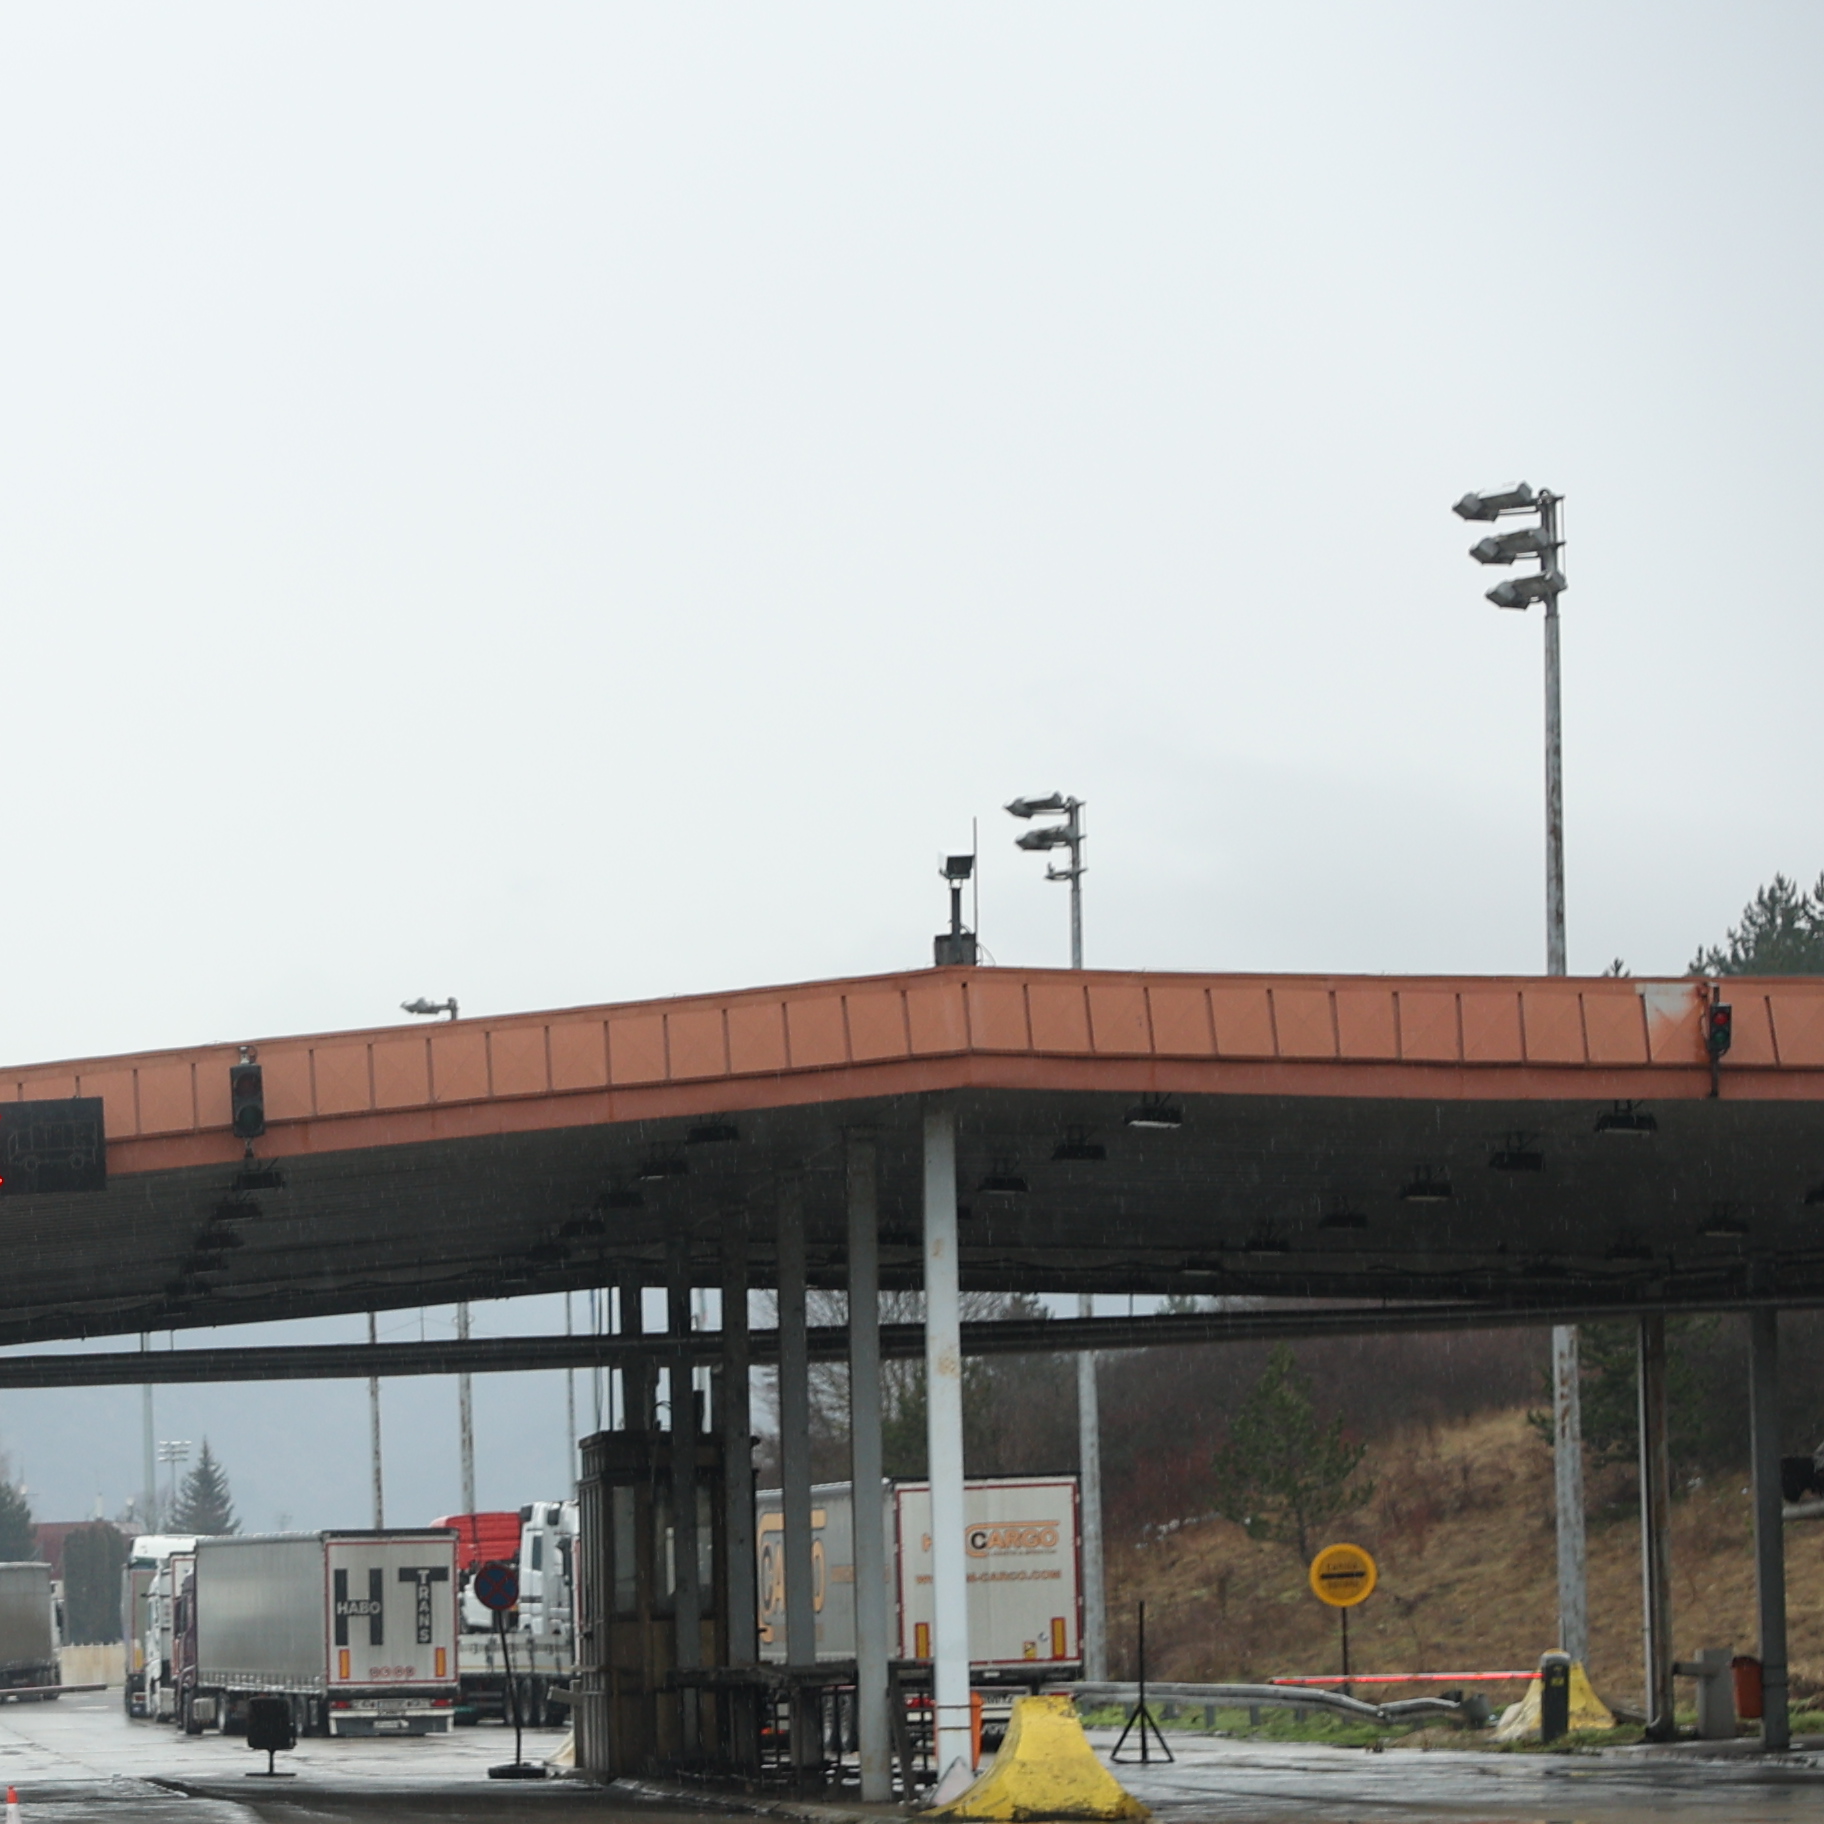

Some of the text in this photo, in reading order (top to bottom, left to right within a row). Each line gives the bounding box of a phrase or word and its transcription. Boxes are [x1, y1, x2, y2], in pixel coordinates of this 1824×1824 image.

[970, 1528, 1059, 1550] CARGO
[337, 1601, 382, 1615] HABO
[417, 1569, 430, 1642] TRANS
